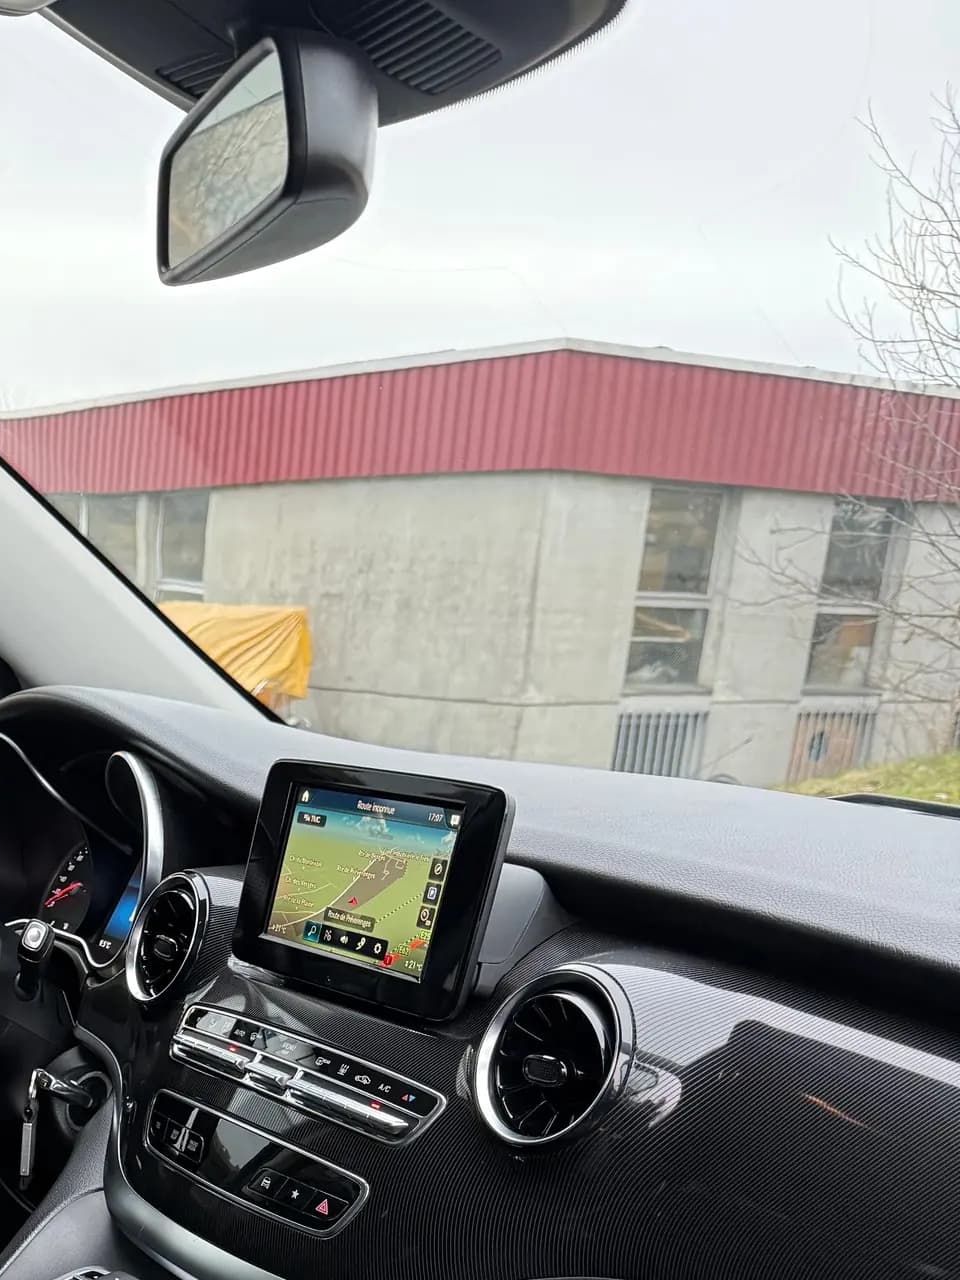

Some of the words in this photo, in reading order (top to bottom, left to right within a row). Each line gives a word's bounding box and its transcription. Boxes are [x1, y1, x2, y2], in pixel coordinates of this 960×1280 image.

[356, 800, 372, 812] Route
[428, 812, 443, 823] 17:07
[377, 1082, 392, 1093] A/C
